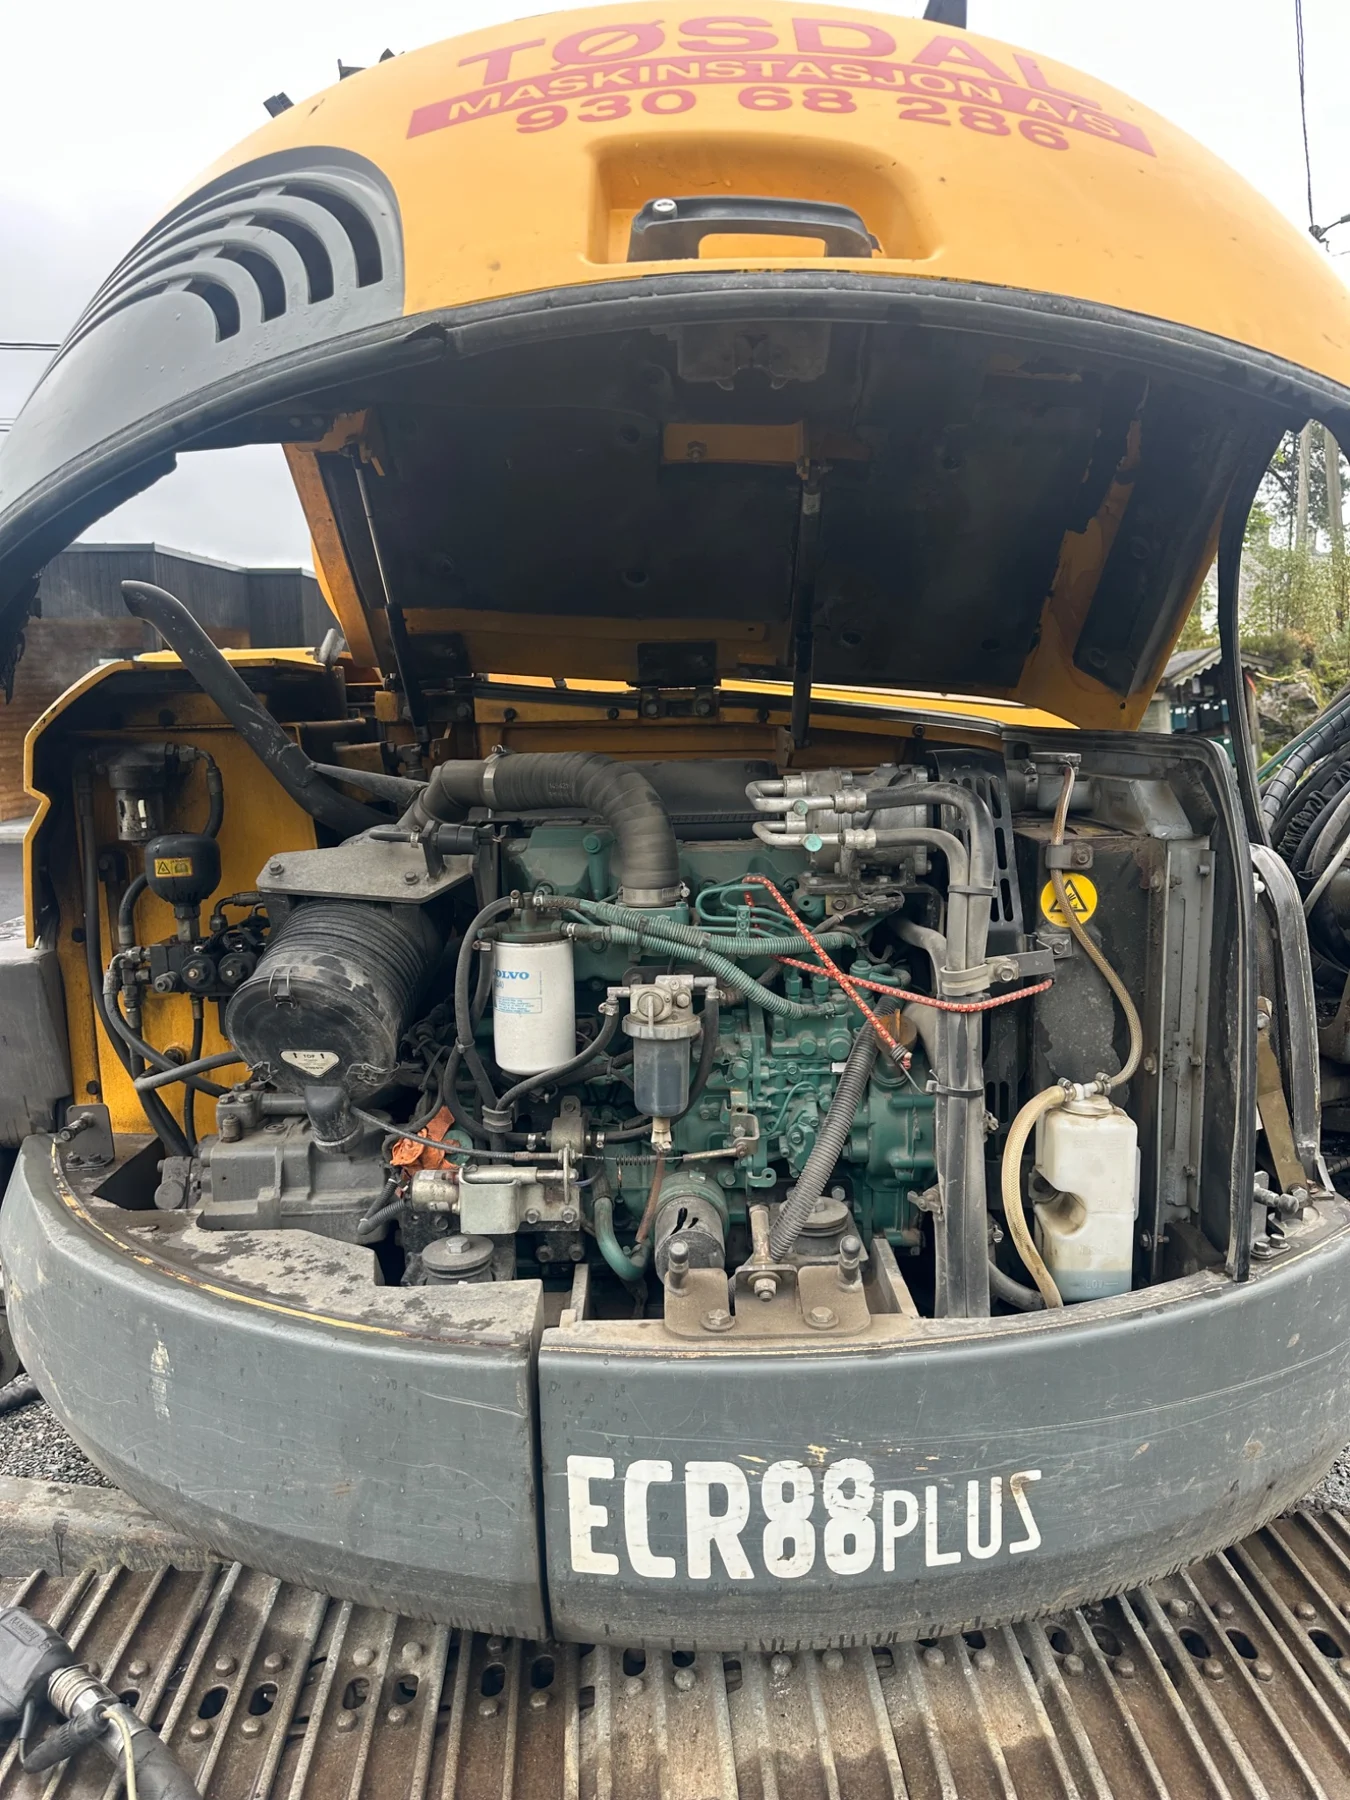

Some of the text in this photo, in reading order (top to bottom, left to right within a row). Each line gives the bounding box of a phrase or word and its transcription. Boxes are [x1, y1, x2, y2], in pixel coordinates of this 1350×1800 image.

[448, 60, 1121, 138] MASKINSTASJON A/S
[457, 15, 1102, 111] TØSDAL
[515, 86, 1069, 151] 930 68 286
